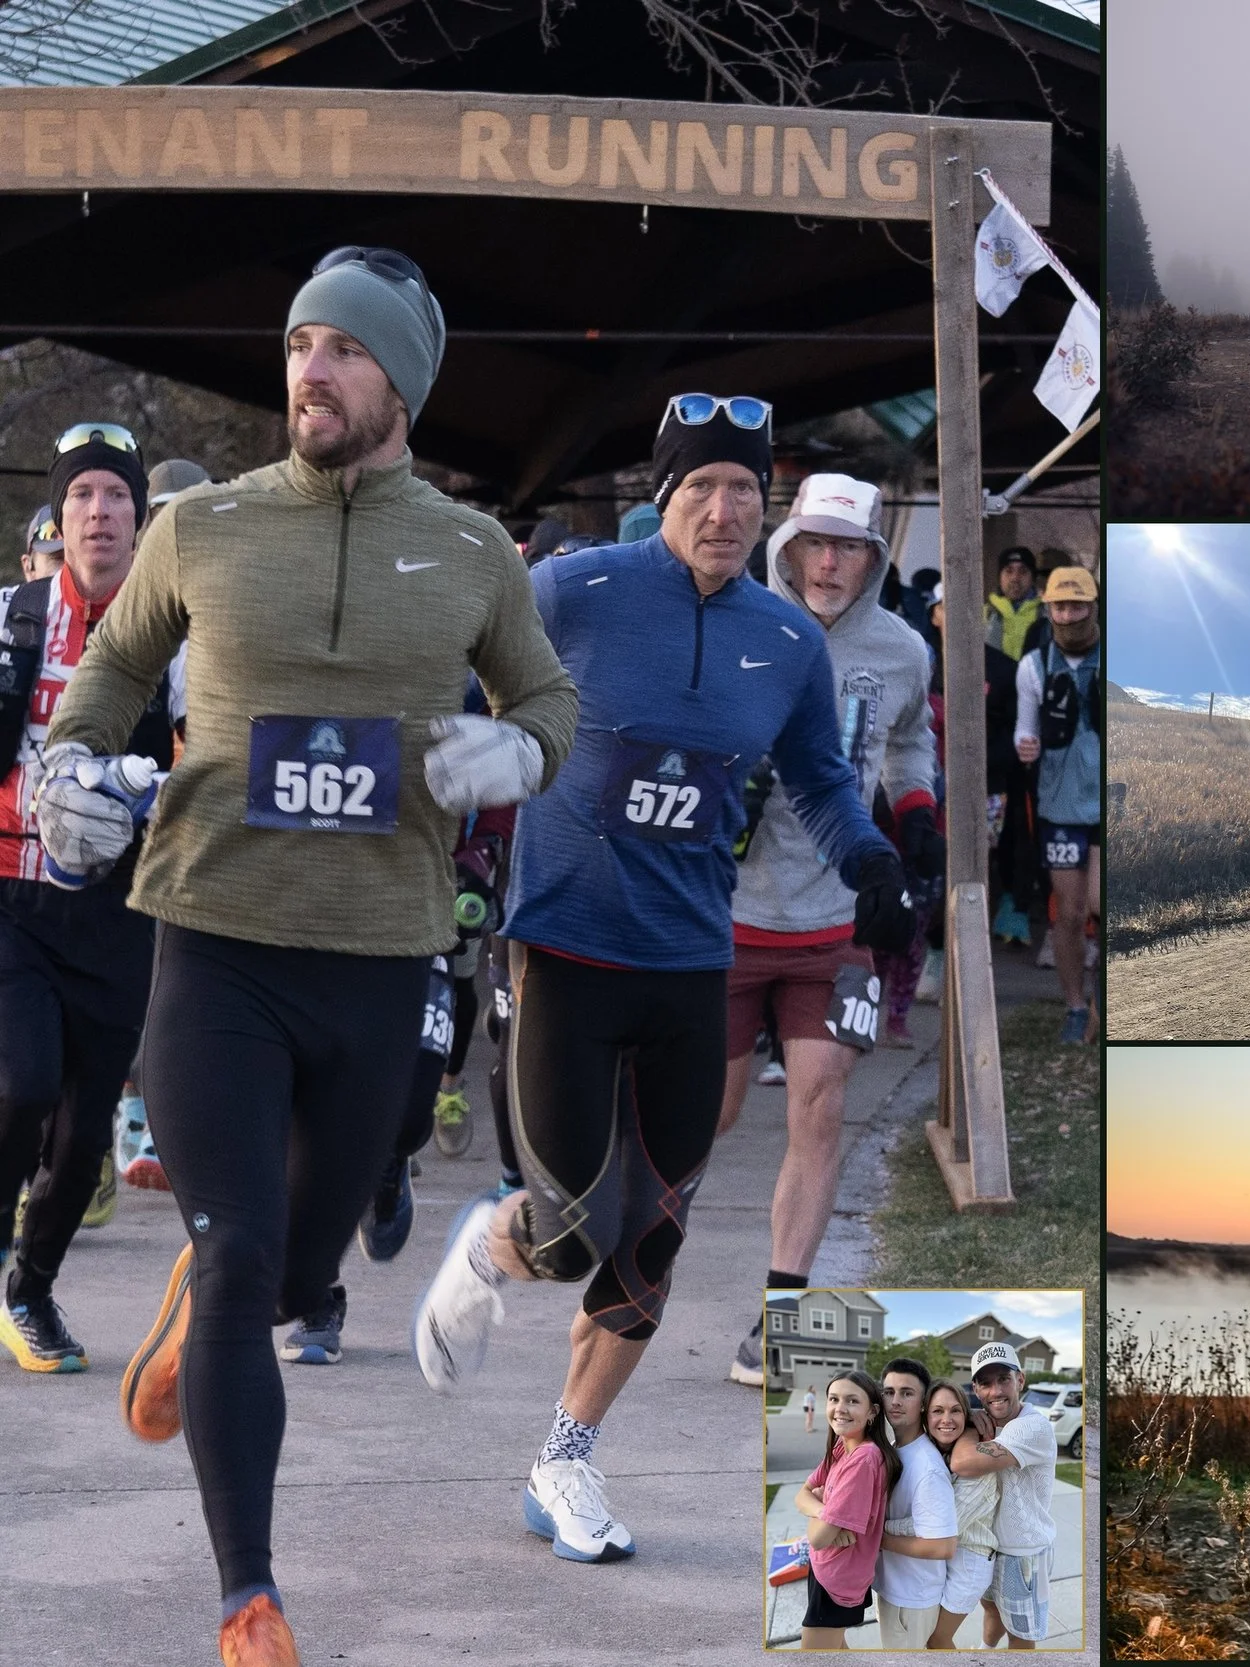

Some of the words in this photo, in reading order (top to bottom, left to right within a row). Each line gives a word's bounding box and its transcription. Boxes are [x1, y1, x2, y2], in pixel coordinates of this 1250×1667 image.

[459, 110, 918, 202] RUNNING
[274, 760, 377, 817] 562
[625, 779, 702, 830] 572
[310, 817, 342, 829] SCOTT
[1046, 842, 1080, 863] 523
